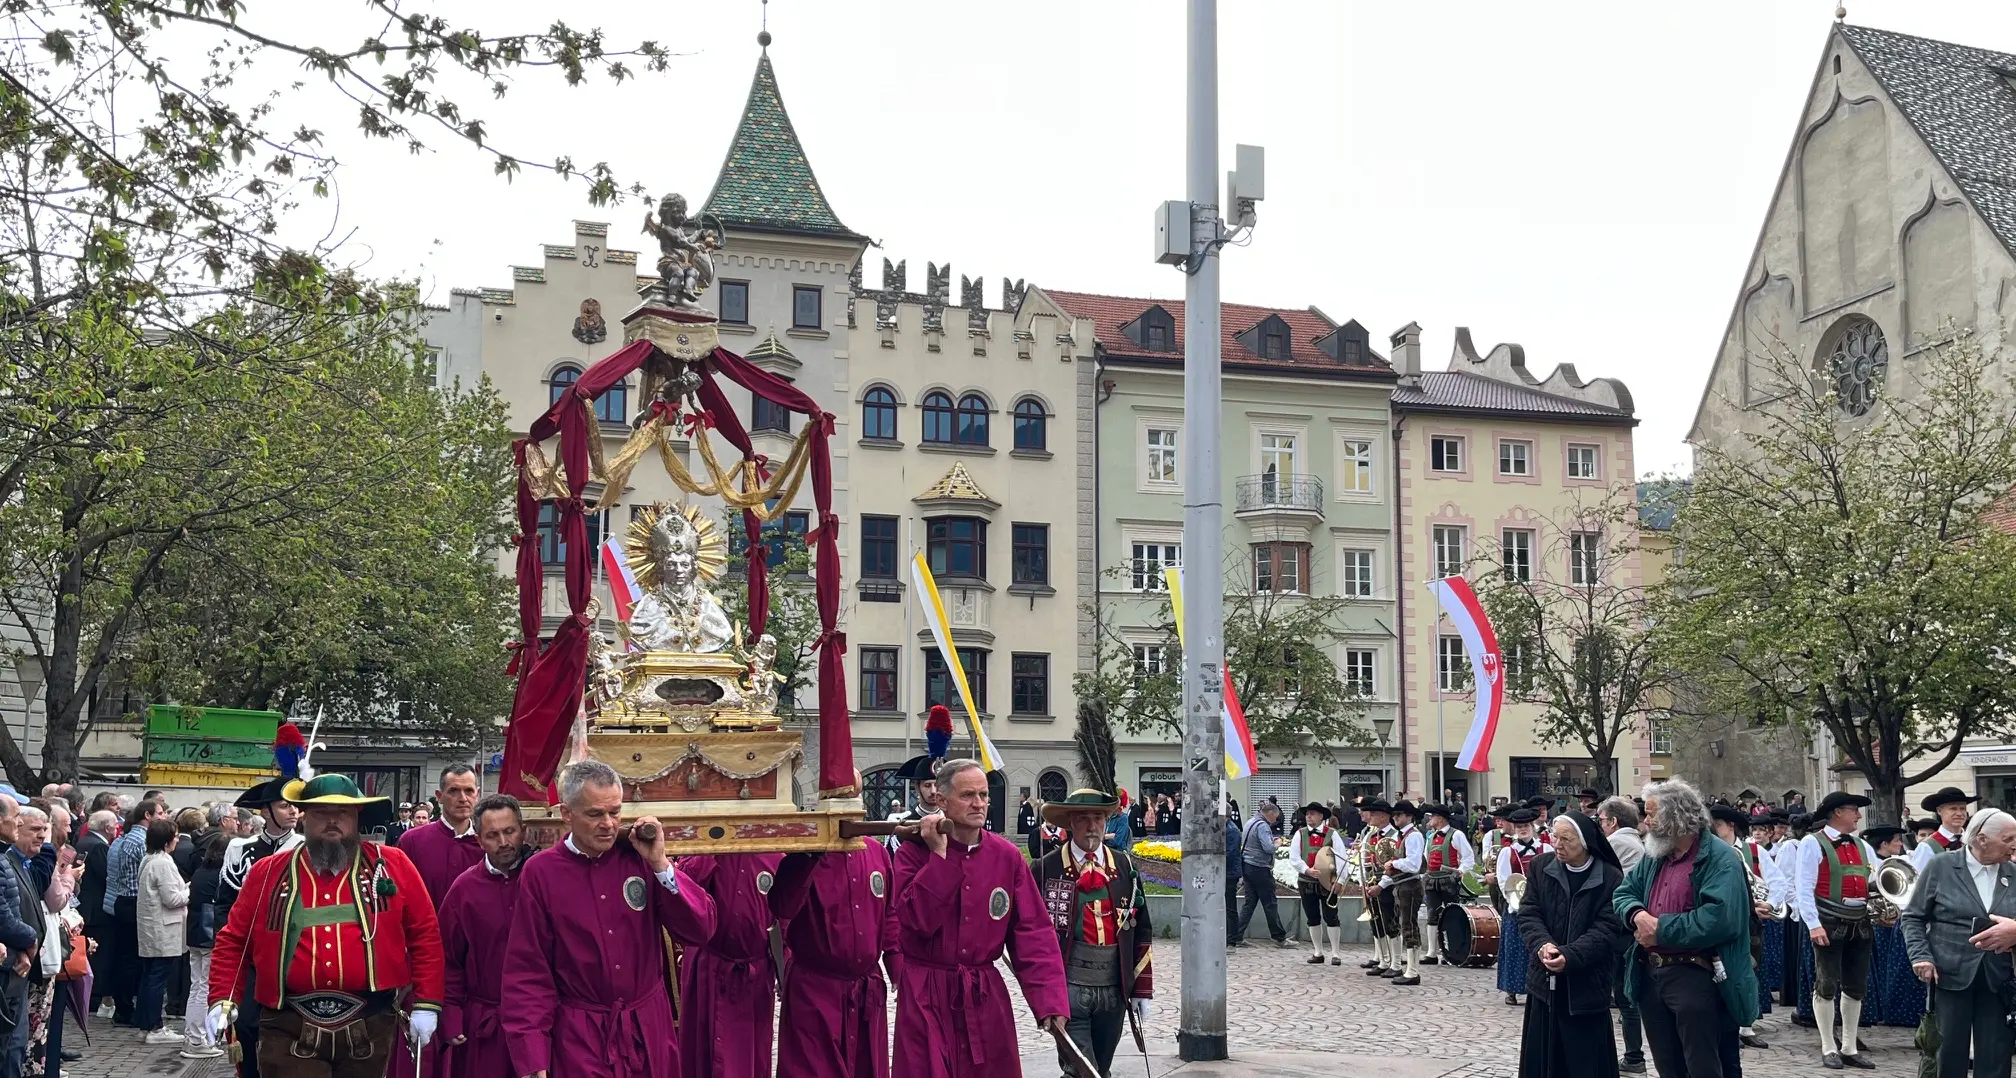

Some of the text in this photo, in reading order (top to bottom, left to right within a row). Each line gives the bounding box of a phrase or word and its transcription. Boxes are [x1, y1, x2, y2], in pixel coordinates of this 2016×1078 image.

[180, 743, 211, 759] 176
[1970, 755, 2009, 764] KINDERMODE
[1150, 772, 1176, 782] globus
[1347, 774, 1371, 784] globus
